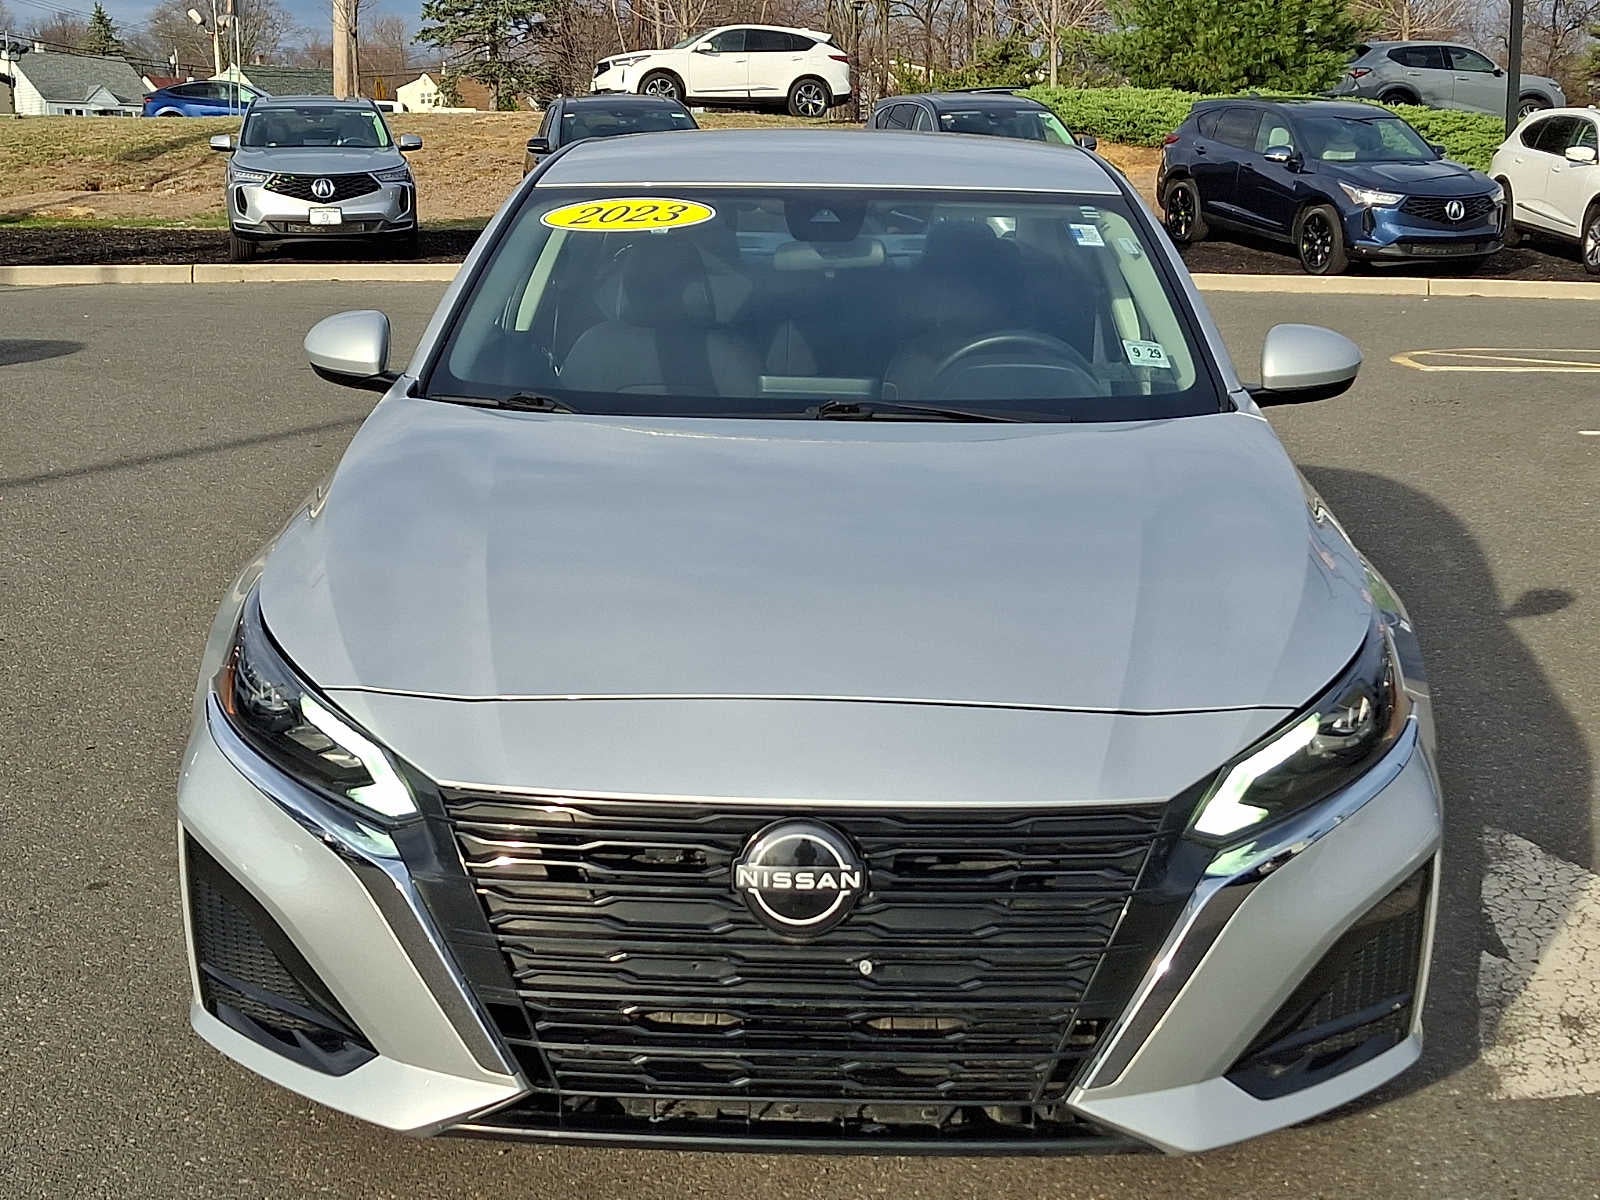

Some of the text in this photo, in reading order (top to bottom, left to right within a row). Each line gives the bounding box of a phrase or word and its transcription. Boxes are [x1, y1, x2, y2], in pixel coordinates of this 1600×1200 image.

[568, 205, 689, 224] 2023
[1132, 347, 1162, 359] 9 29
[738, 870, 861, 889] NISSAN
